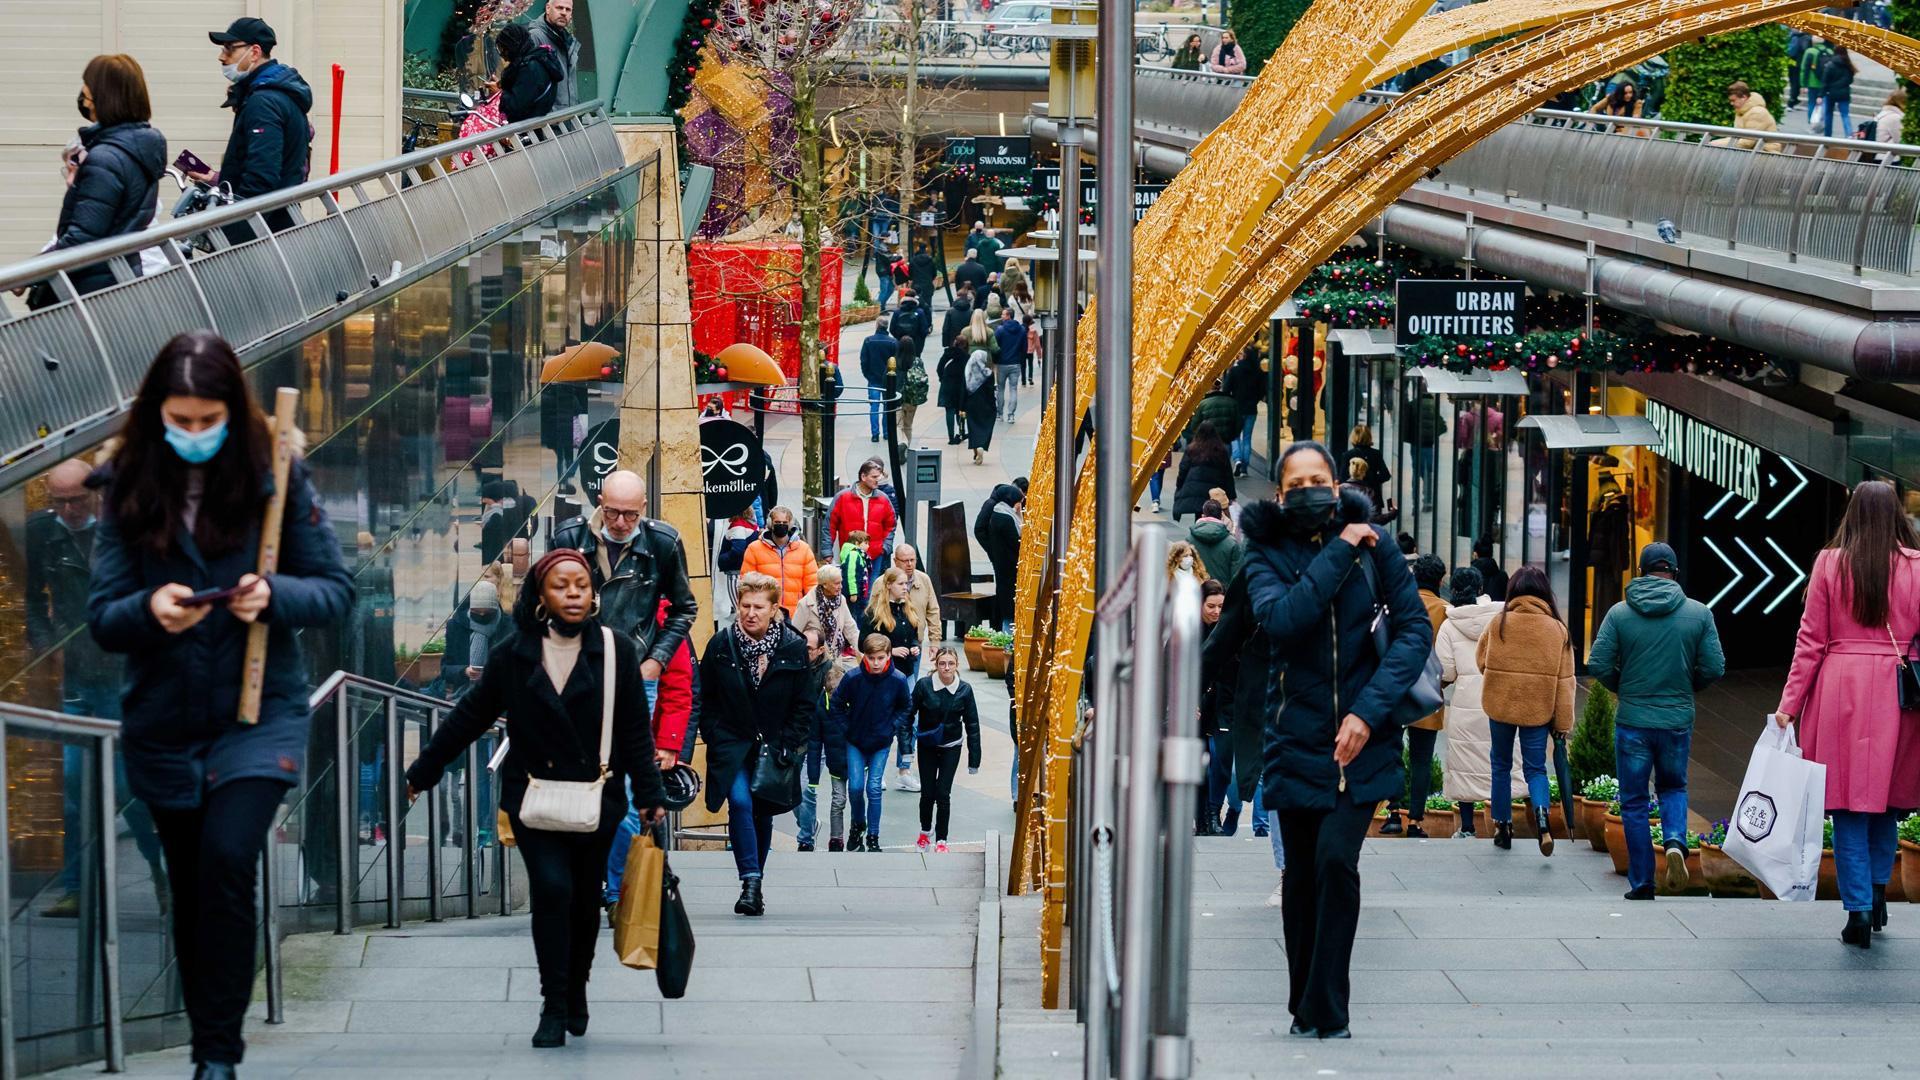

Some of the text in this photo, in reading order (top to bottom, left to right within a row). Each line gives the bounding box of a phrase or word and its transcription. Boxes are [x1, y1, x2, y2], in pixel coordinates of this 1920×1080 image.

[979, 156, 1026, 165] SWAROVSKI
[1135, 192, 1159, 205] BAN
[1456, 291, 1515, 311] URBAN
[1408, 315, 1514, 335] OUTFITTERS
[1685, 418, 1760, 504] OUTFITTERS
